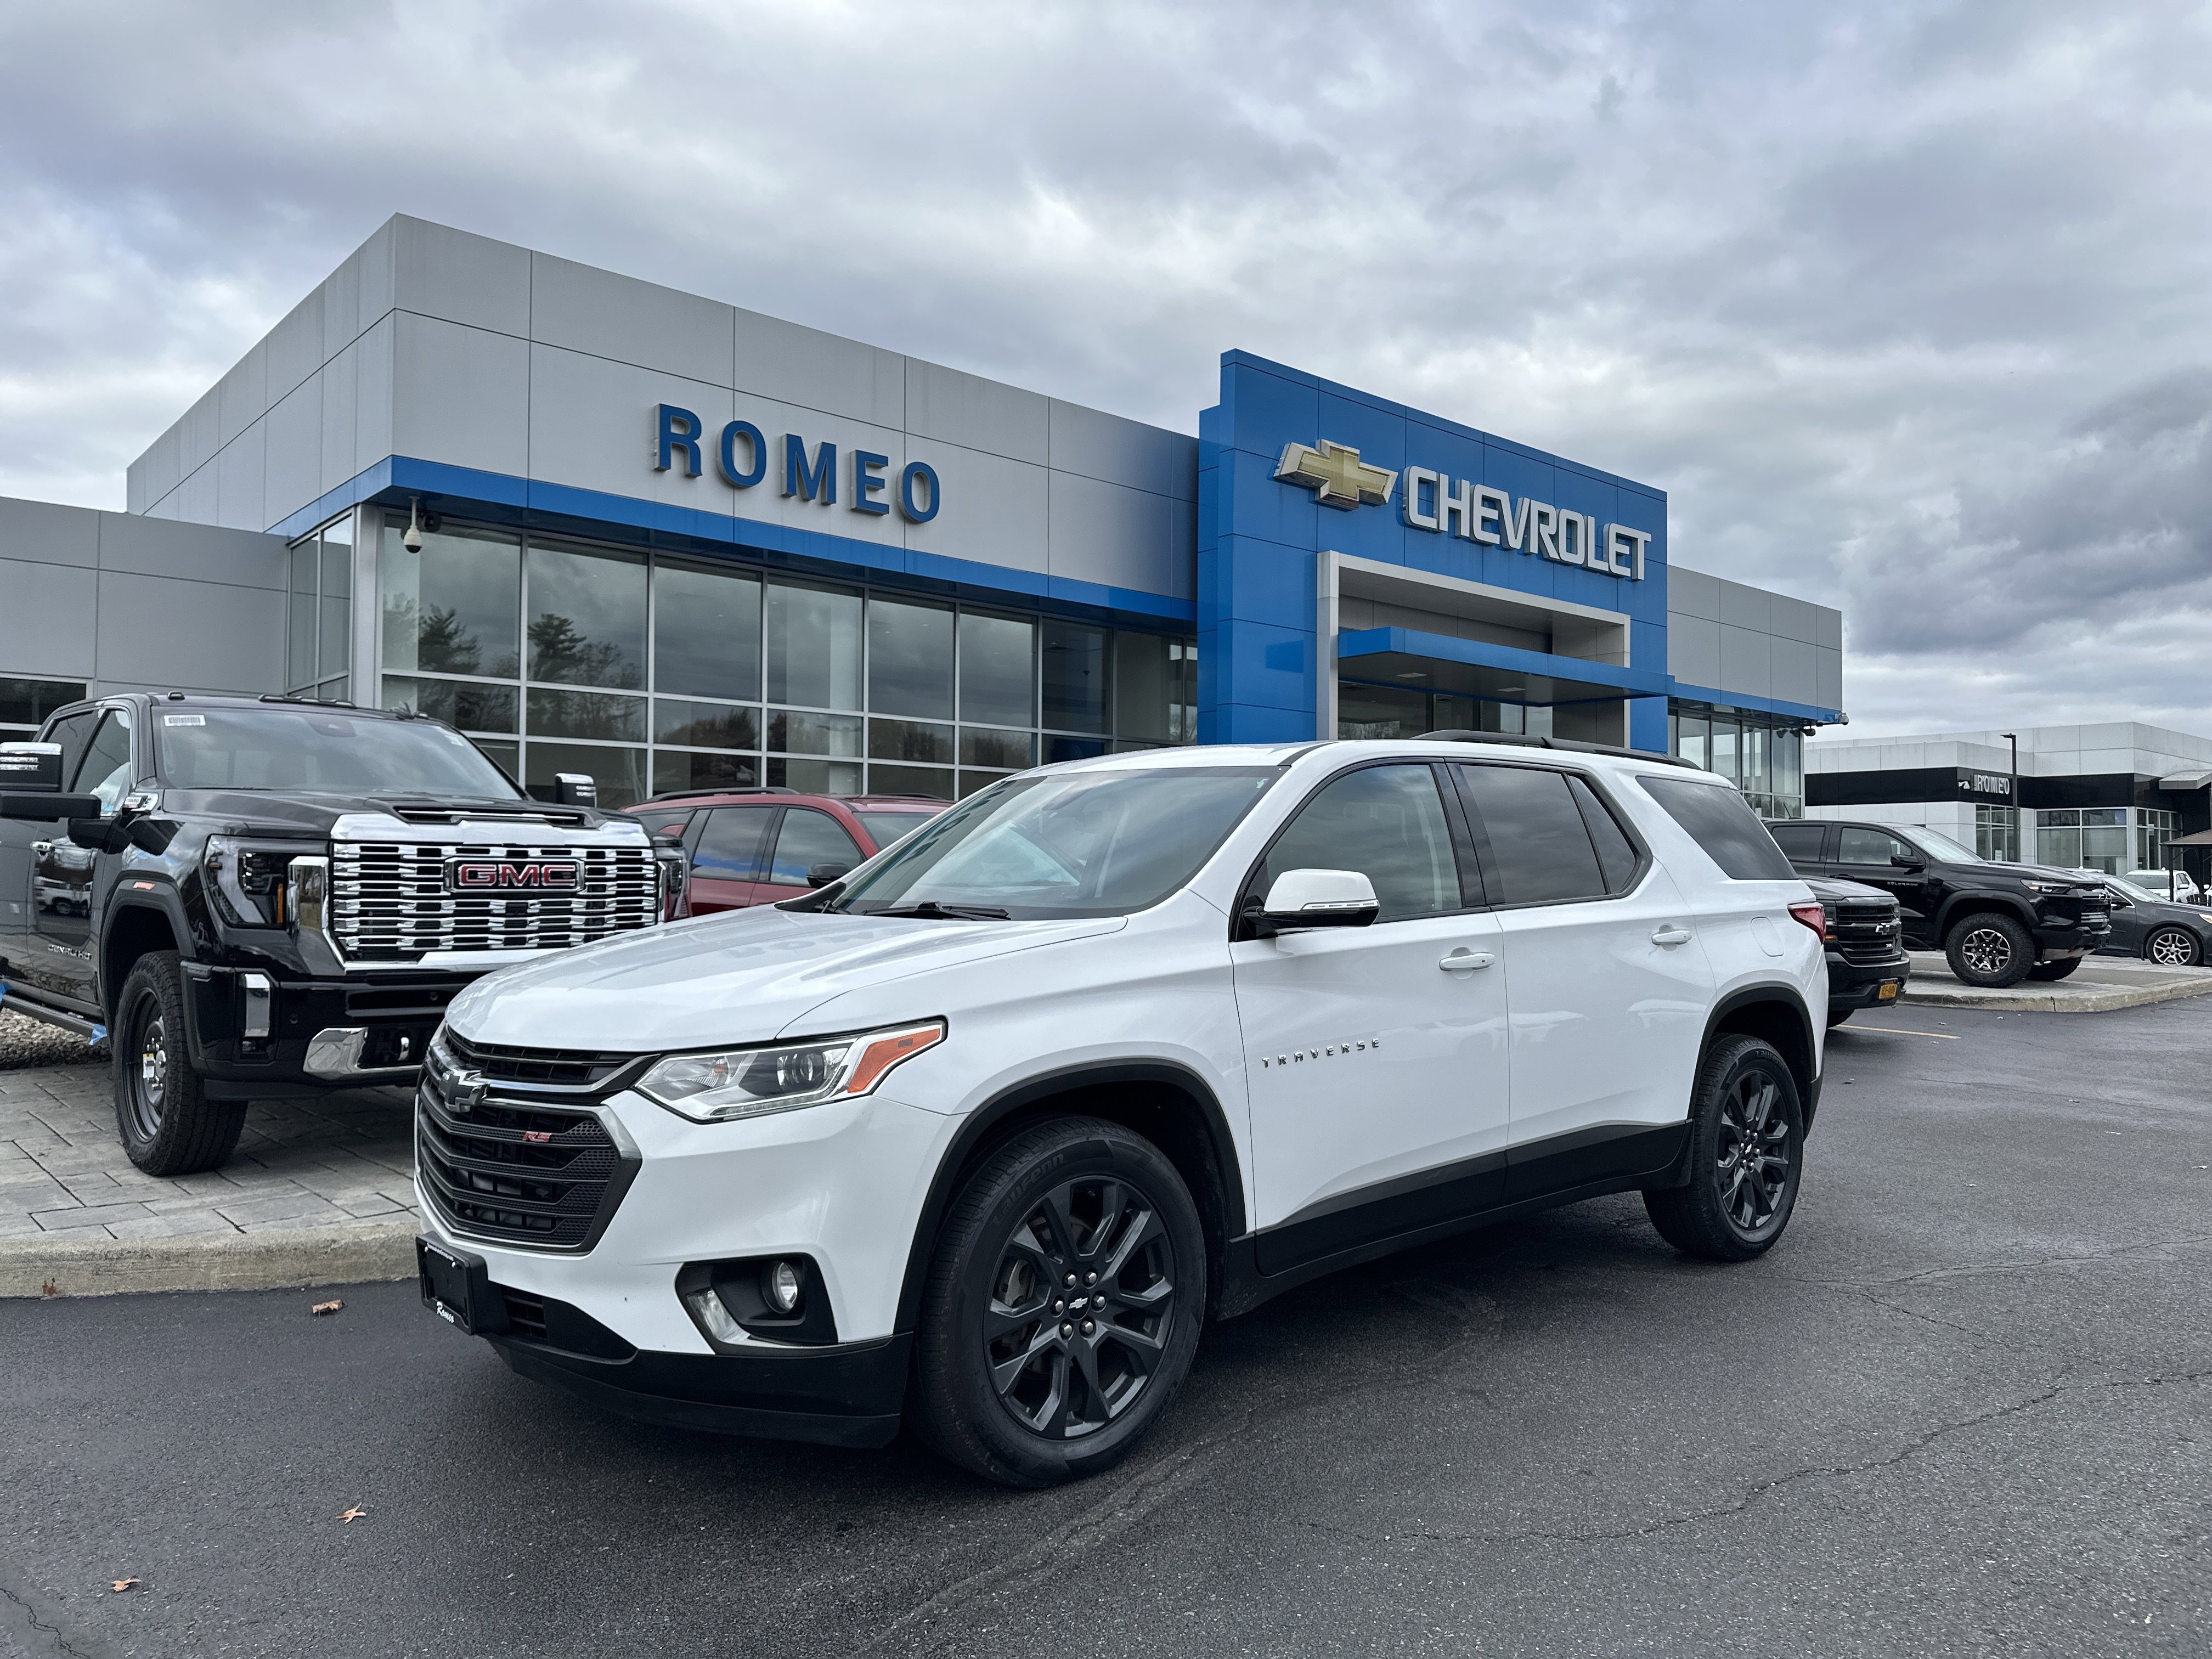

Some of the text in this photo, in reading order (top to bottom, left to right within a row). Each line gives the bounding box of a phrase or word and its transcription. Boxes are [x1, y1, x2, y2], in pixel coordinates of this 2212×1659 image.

[654, 403, 940, 523] ROMEO
[1402, 465, 1652, 580] CHEVROLET
[1974, 774, 2010, 795] ROMEO
[458, 864, 575, 887] GMC
[1262, 1038, 1380, 1068] TRAVERSE
[522, 1131, 552, 1142] RS
